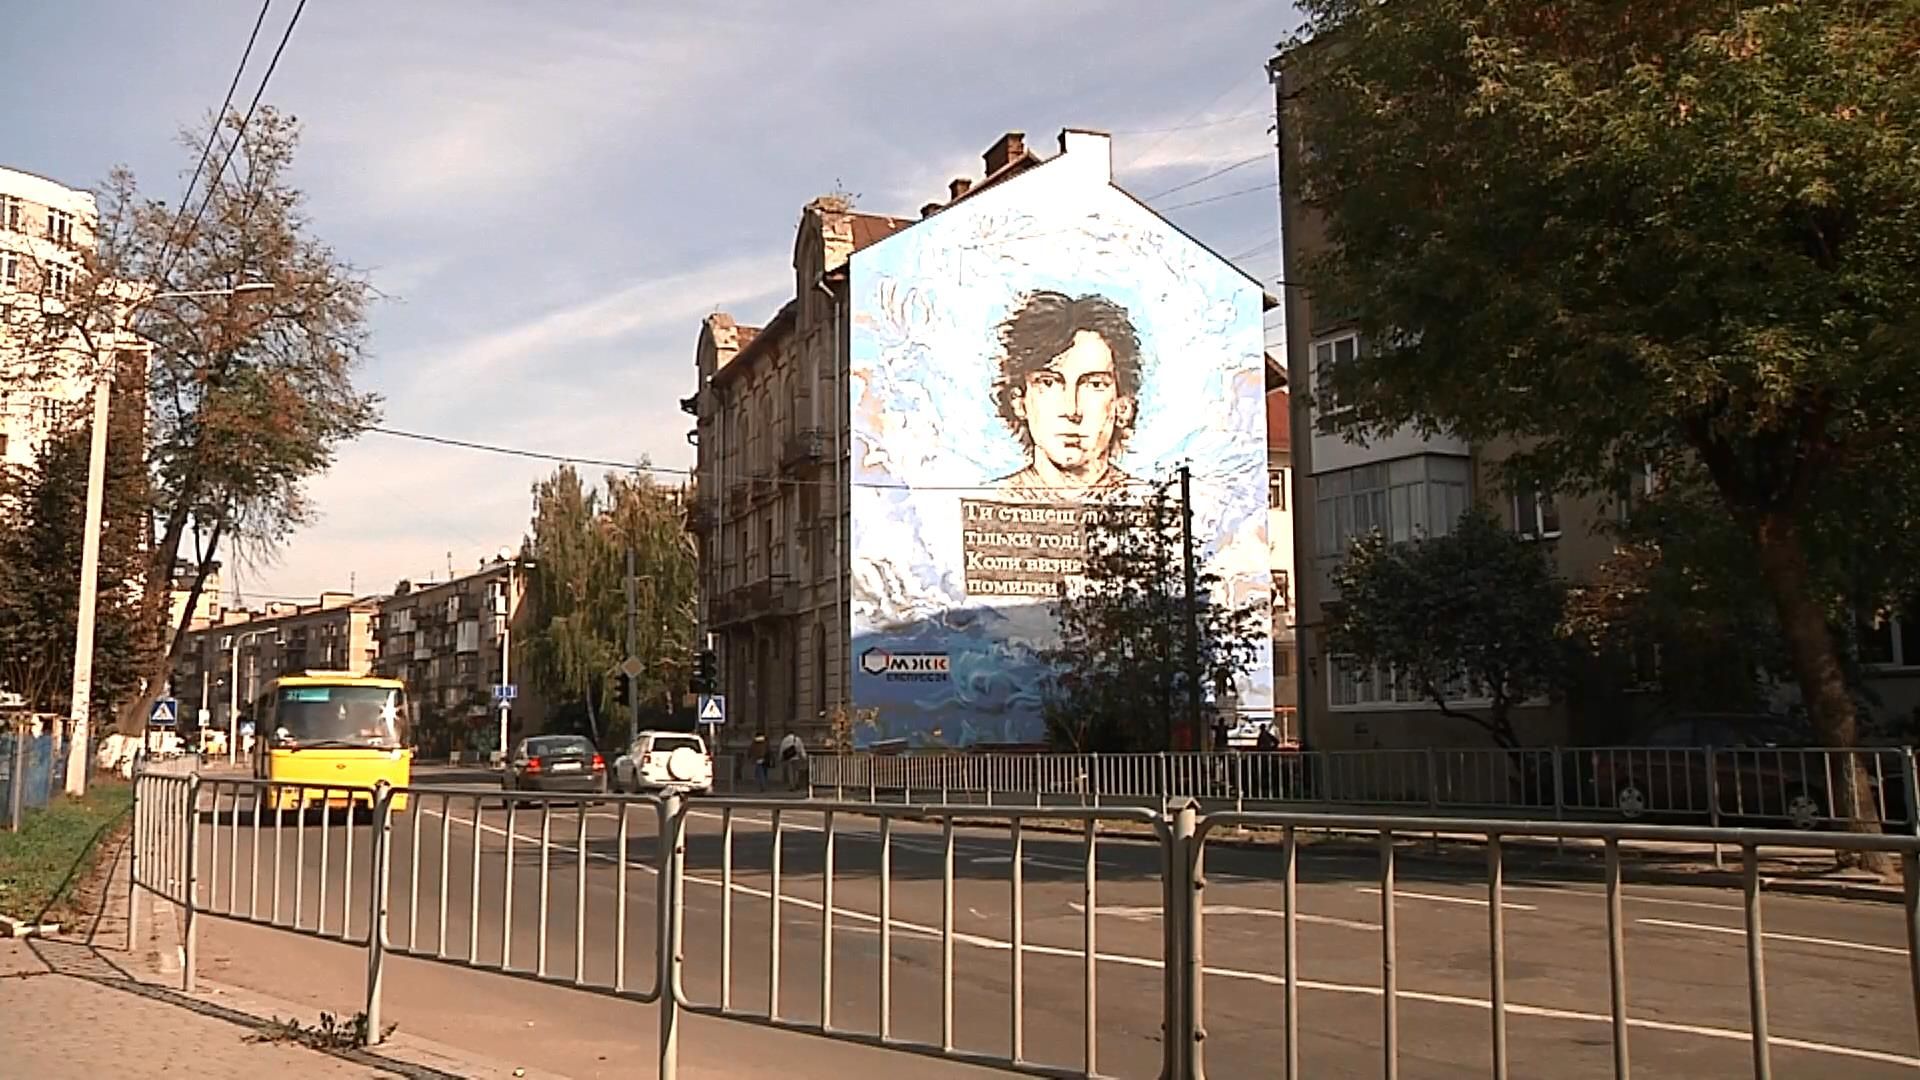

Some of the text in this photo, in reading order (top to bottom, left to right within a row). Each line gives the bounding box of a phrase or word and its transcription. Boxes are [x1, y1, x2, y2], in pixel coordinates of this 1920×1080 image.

[963, 501, 993, 520] Ти
[998, 507, 1077, 524] станеш
[964, 527, 1032, 547] тільки
[966, 551, 1021, 570] Коли
[967, 580, 1057, 594] помилки
